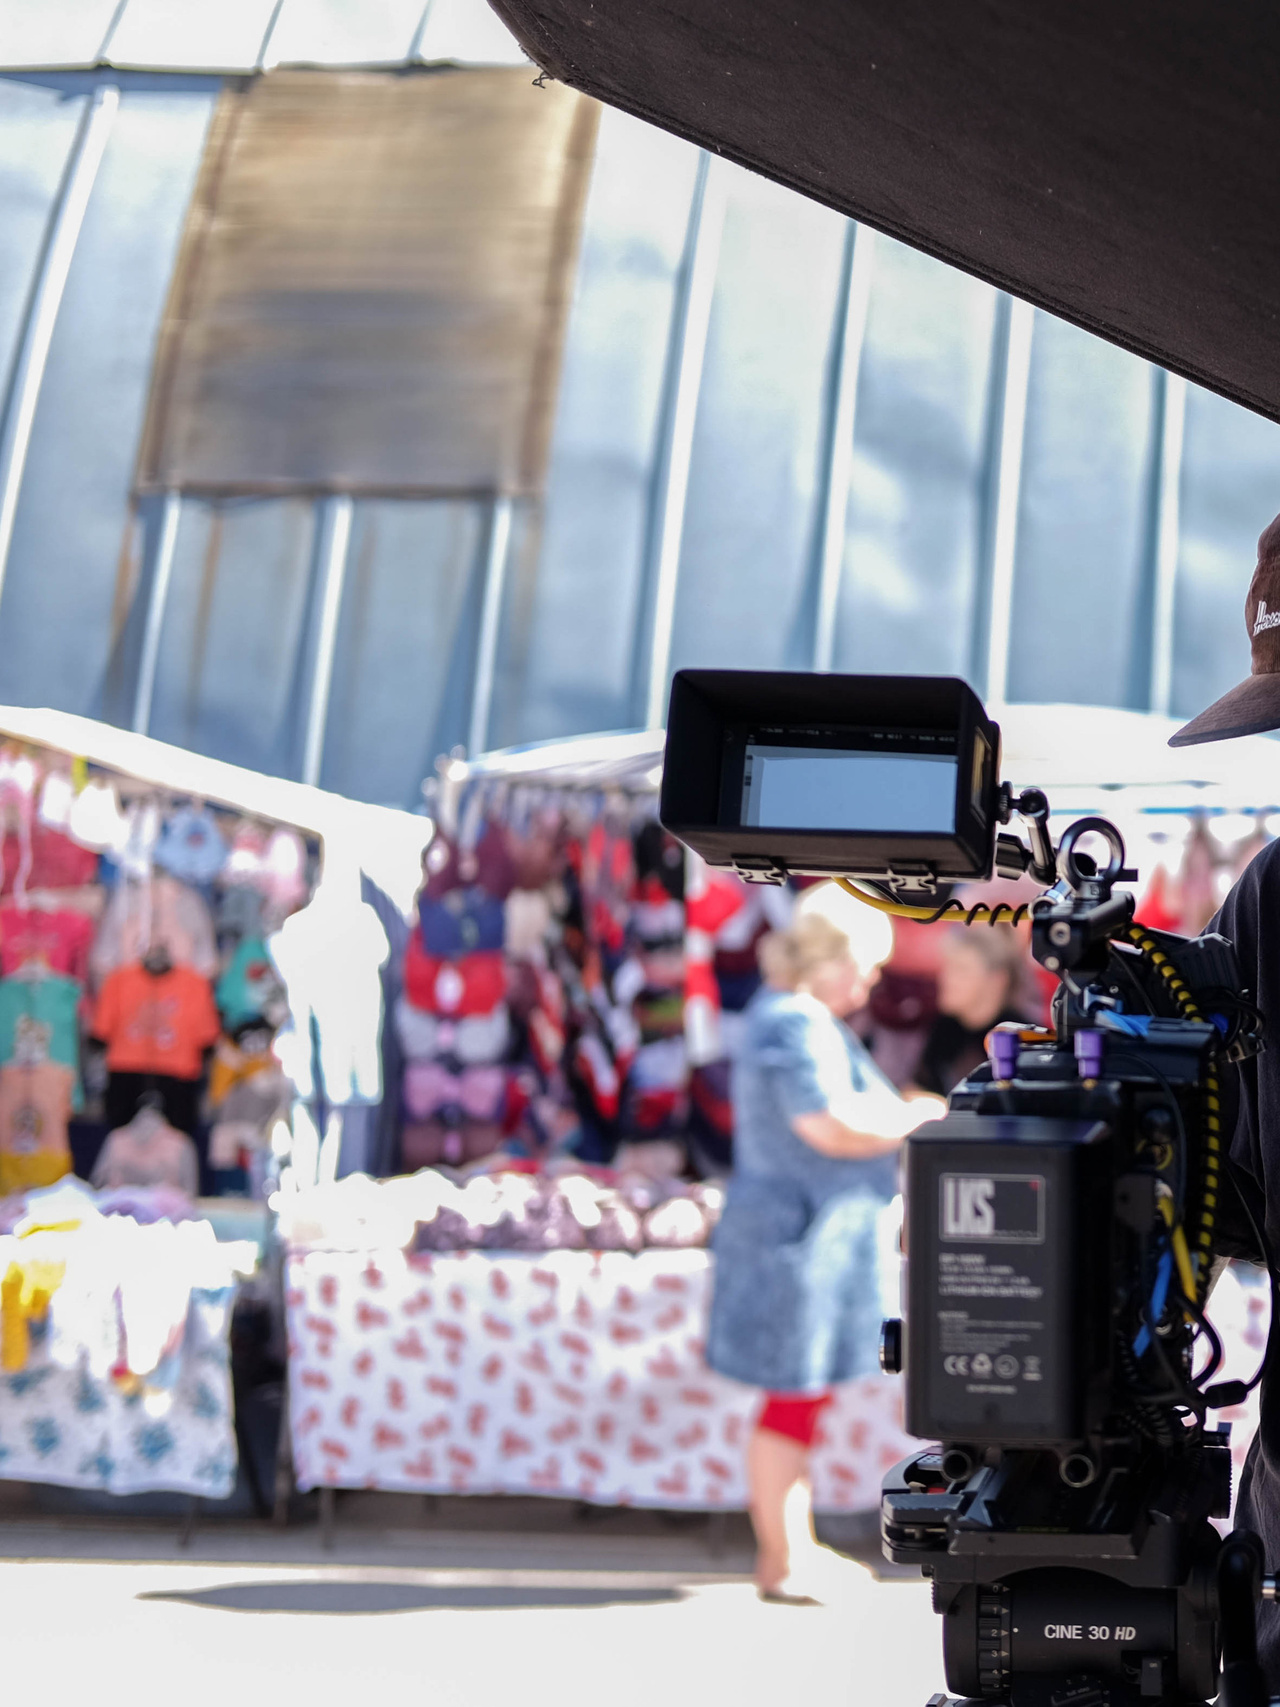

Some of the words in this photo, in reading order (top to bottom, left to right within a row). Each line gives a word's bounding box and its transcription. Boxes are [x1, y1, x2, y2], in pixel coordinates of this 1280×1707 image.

[992, 1584, 999, 1593] 0
[992, 1606, 998, 1615] 1
[991, 1628, 998, 1638] 2
[1044, 1624, 1083, 1640] CINE
[1088, 1625, 1110, 1641] 30
[1114, 1626, 1137, 1641] HD
[991, 1649, 998, 1658] 3
